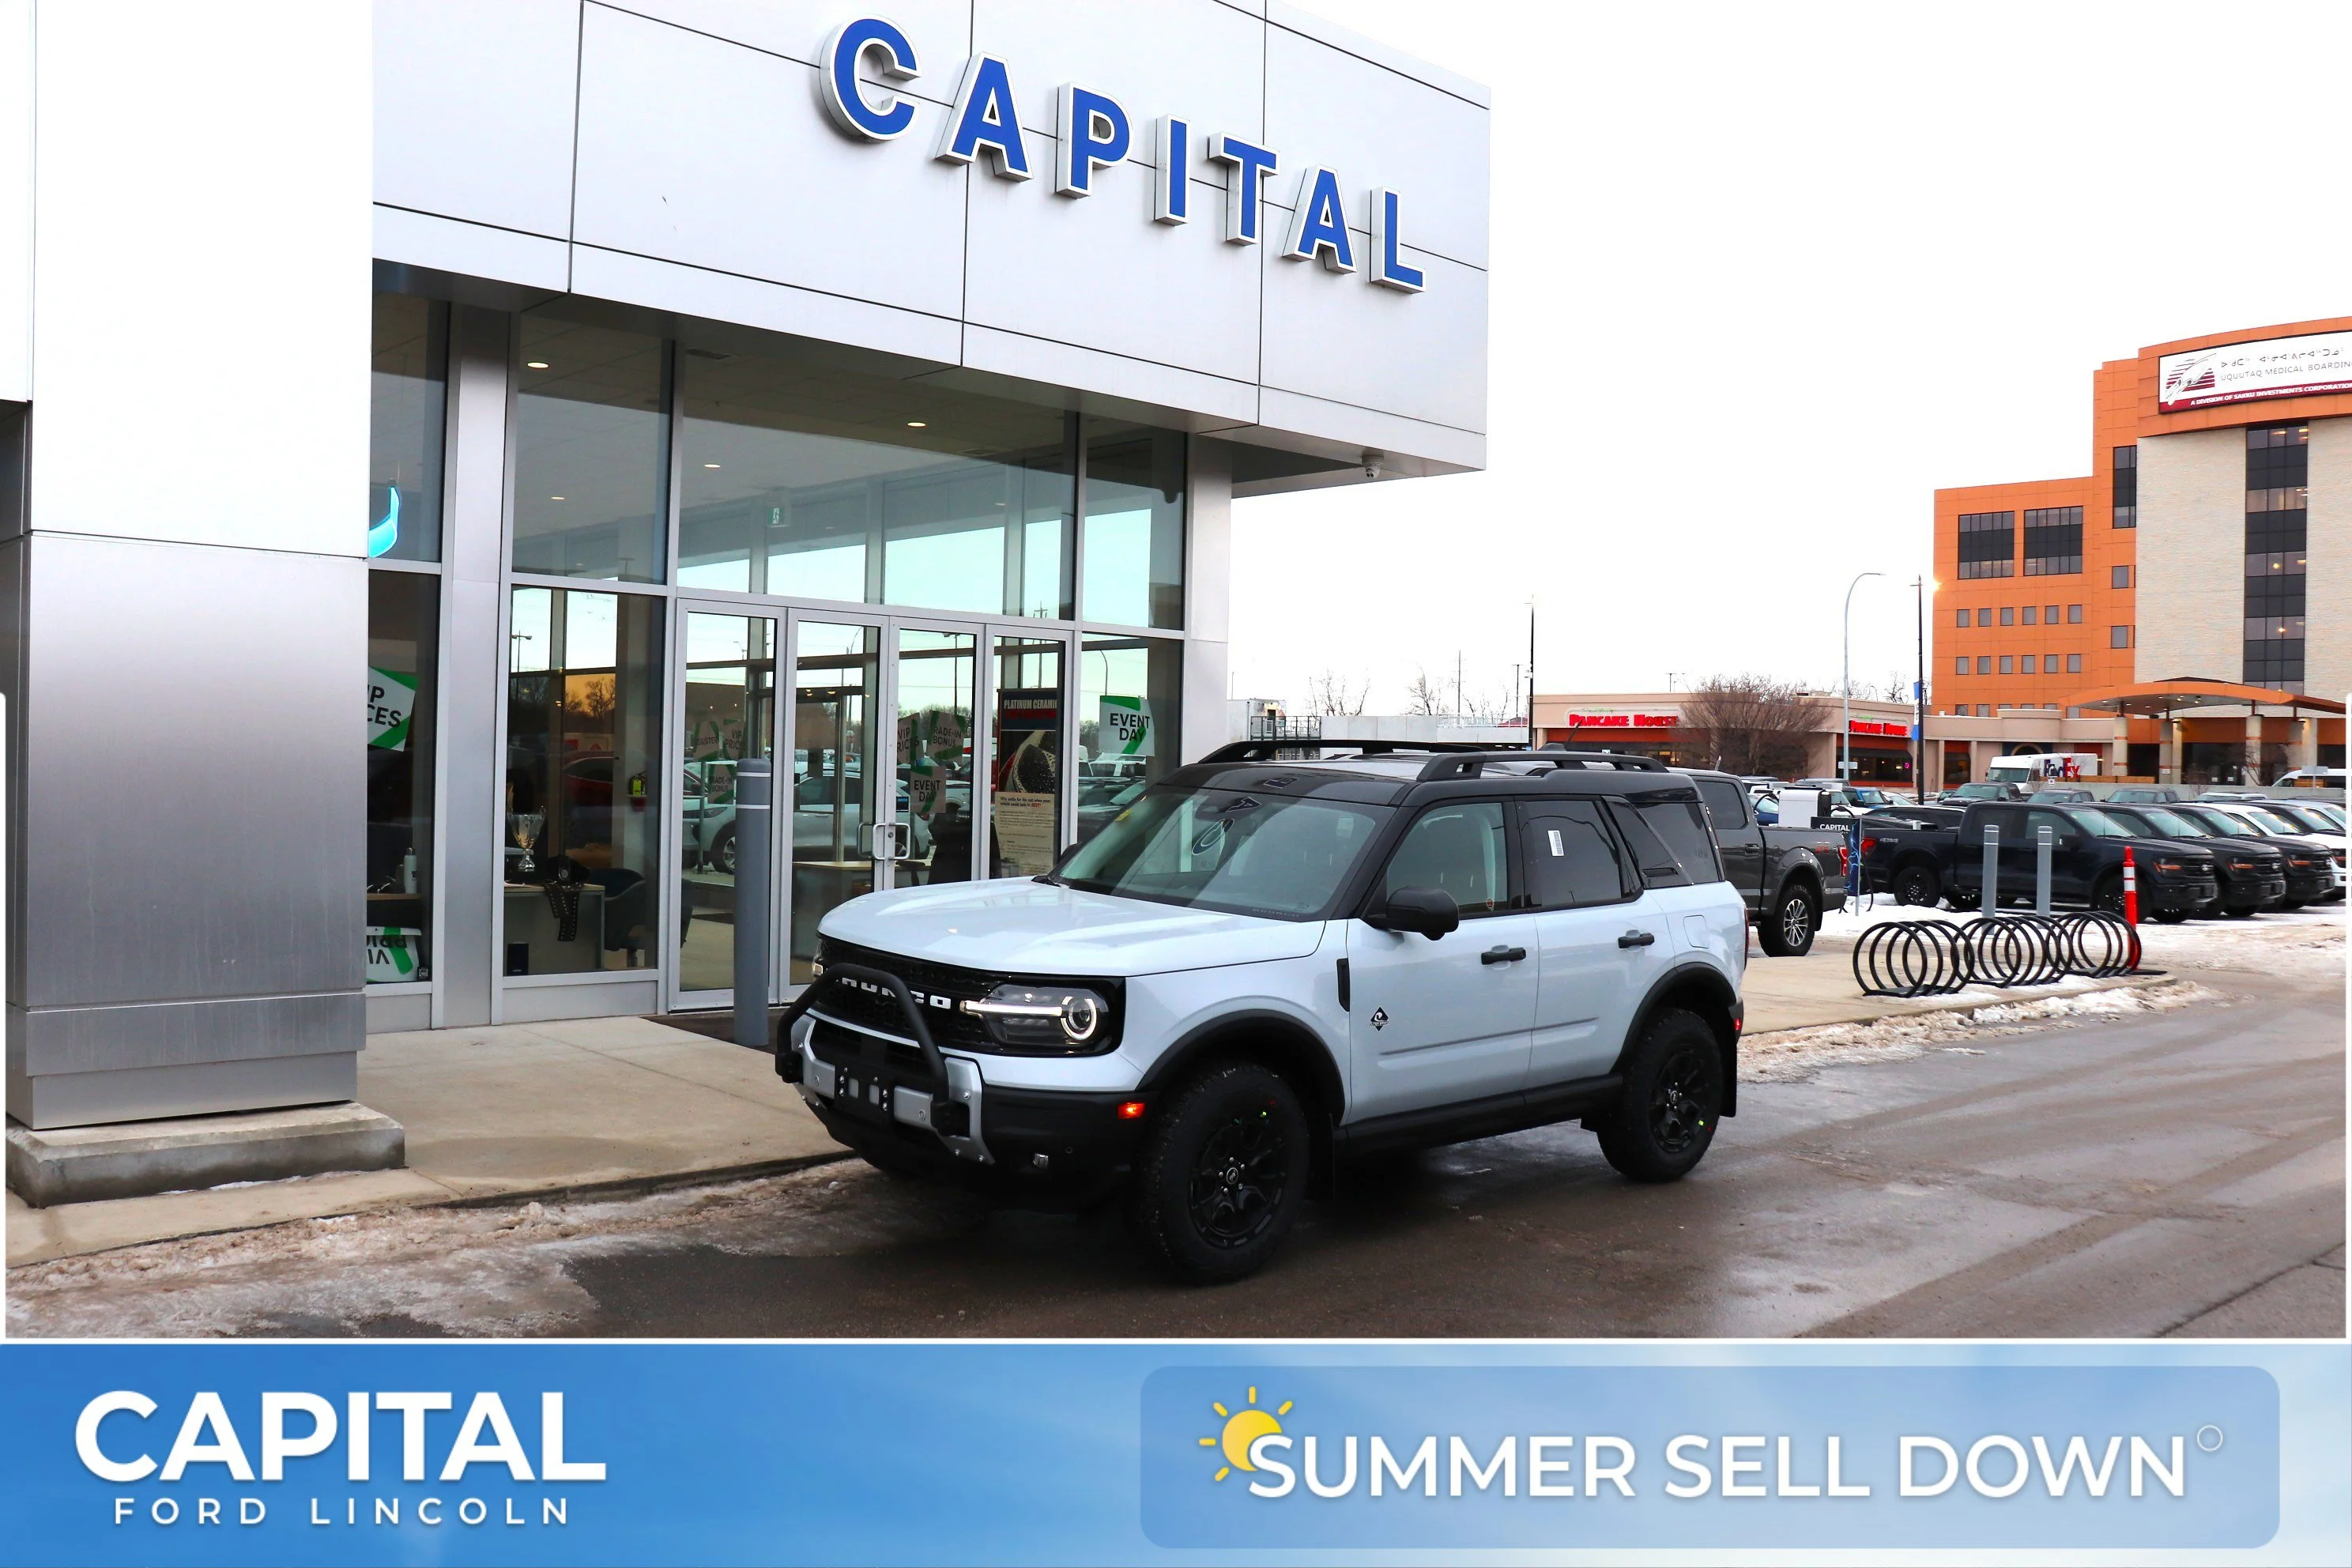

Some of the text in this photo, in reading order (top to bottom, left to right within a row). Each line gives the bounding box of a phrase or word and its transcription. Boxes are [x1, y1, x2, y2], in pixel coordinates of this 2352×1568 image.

[819, 13, 1427, 293] CAPITAL
[2221, 370, 2262, 381] UQUUTAQ
[2265, 366, 2304, 375] MEDICAL
[2196, 396, 2223, 405] DIVISION
[2256, 386, 2303, 397] INVESTMENTS
[1004, 699, 1032, 709] PLATINUM
[1110, 713, 1150, 729] EVENT
[1569, 714, 1678, 726] PANCAKE HOUSE
[731, 729, 742, 739] VIP
[897, 727, 910, 739] VIP
[1119, 727, 1145, 741] DAY
[933, 736, 956, 747] BONUS
[914, 779, 940, 791] EVENT
